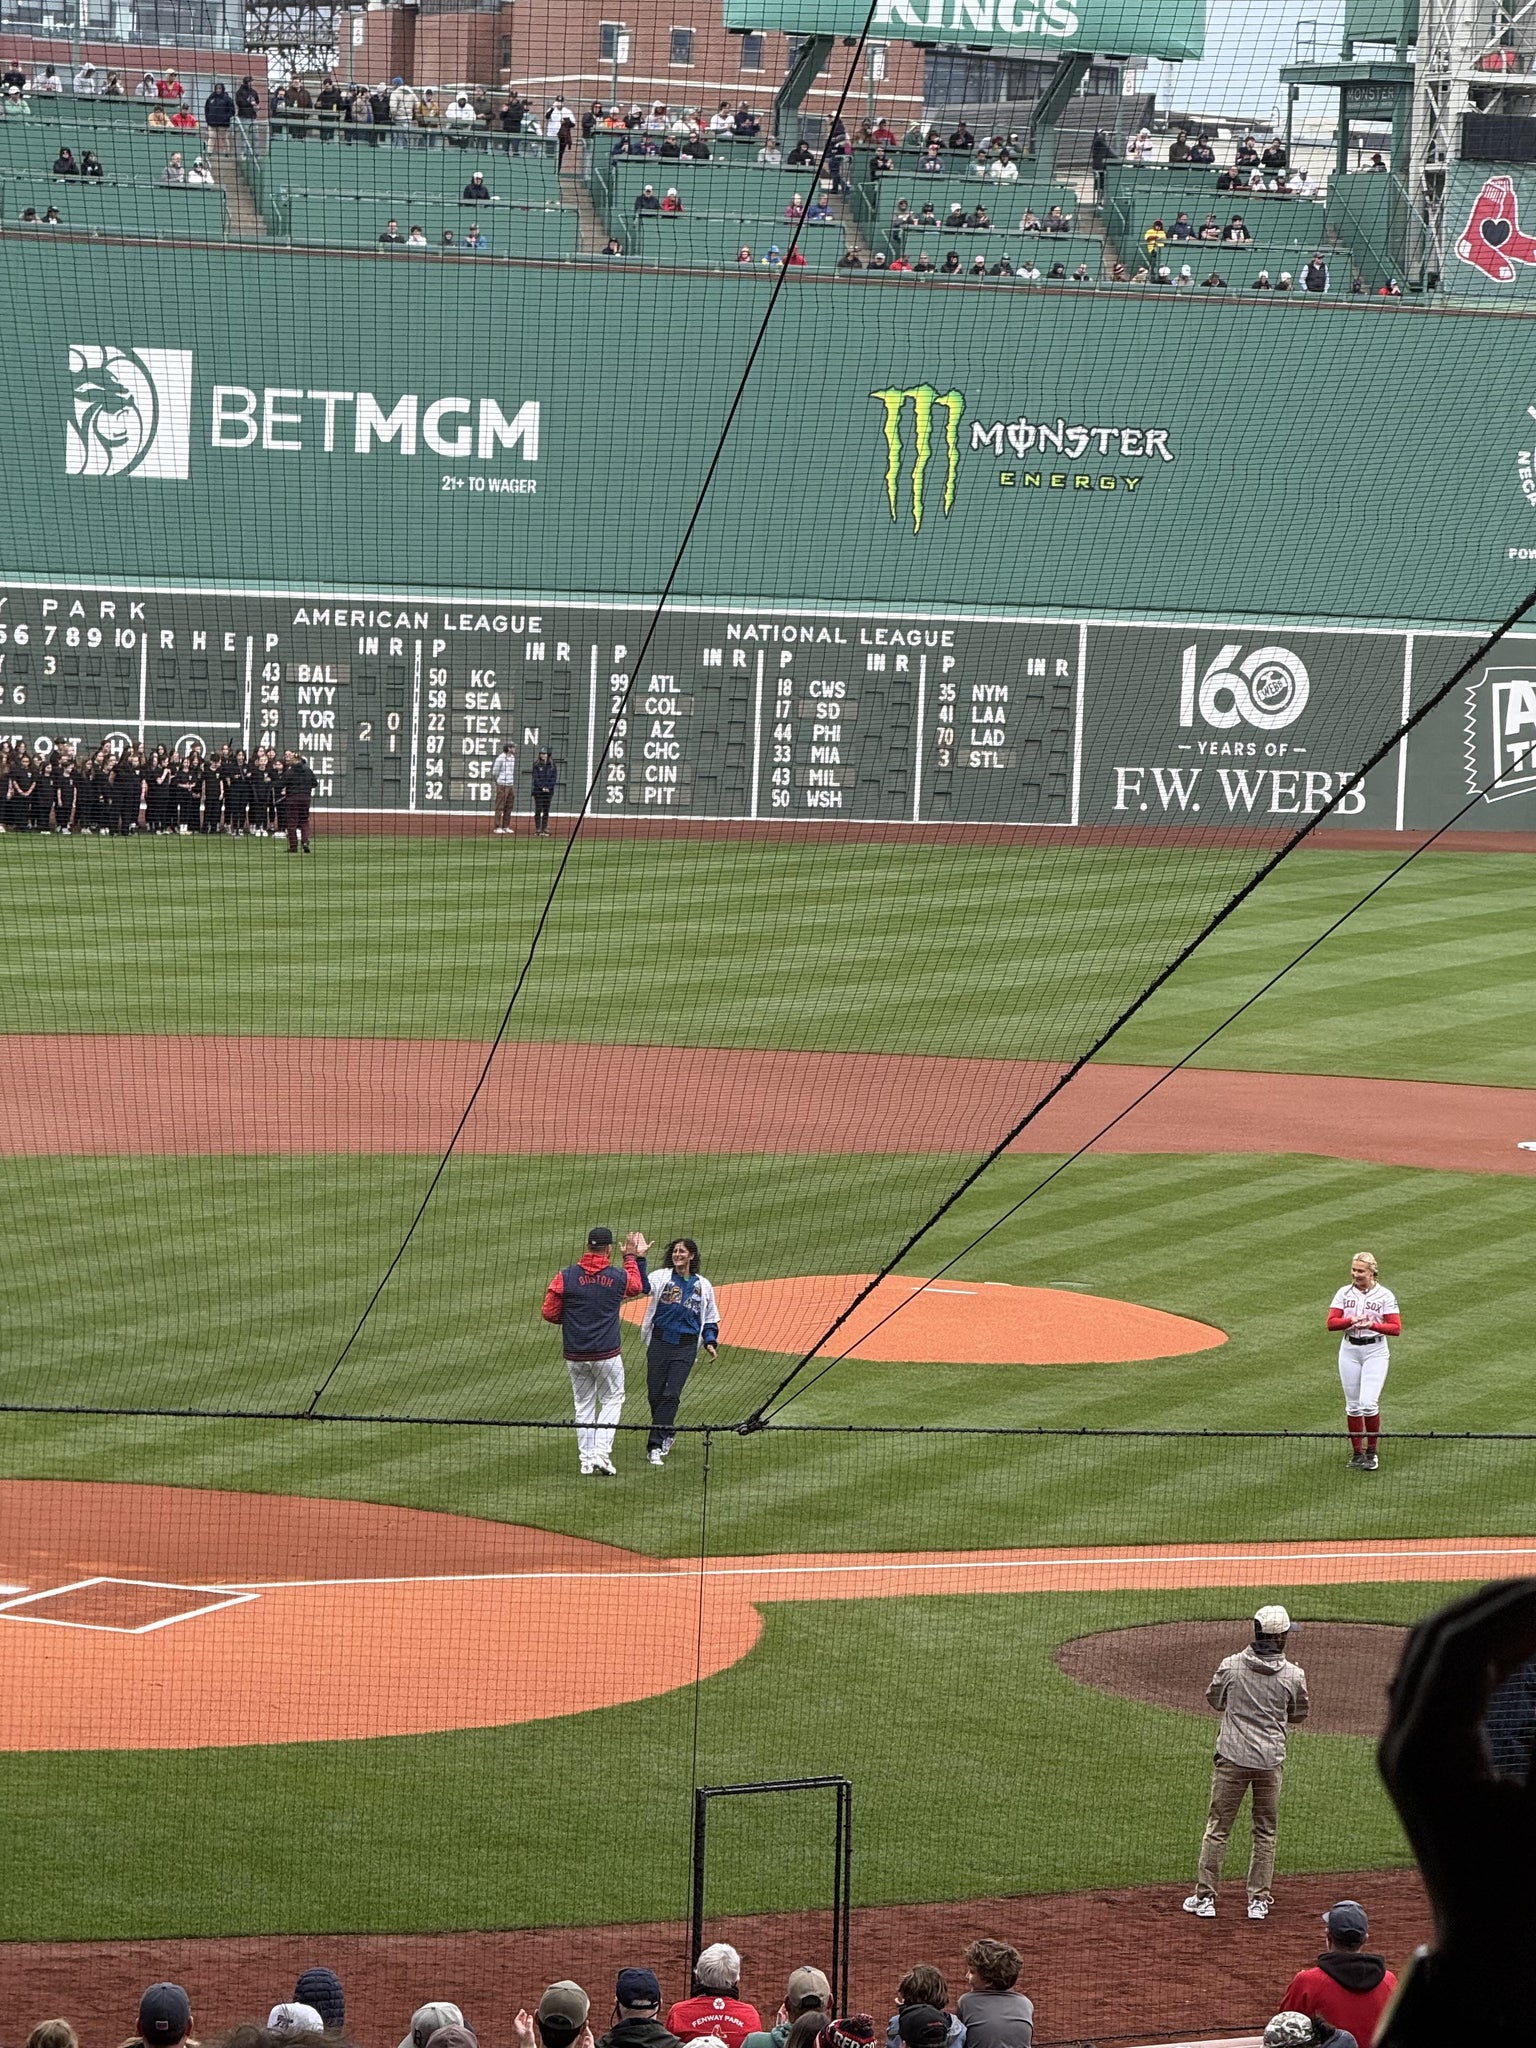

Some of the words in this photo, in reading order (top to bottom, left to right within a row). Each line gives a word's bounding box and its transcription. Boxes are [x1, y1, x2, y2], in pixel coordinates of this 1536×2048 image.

[1347, 86, 1394, 101] MONSTER
[211, 384, 542, 462] BETMGM
[970, 416, 1175, 463] MONSTER
[441, 475, 465, 491] 21+
[468, 476, 485, 492] TO
[488, 478, 537, 494] WAGER
[1000, 471, 1142, 492] ENERGY
[42, 598, 146, 621] PARK
[292, 607, 429, 630] AMERICAN
[443, 613, 543, 634] LEAGUE
[13, 623, 29, 646] 6
[44, 625, 58, 646] 7
[65, 626, 81, 647] 8
[86, 627, 102, 648] 9
[114, 627, 136, 649] 10
[160, 629, 175, 649] R
[192, 630, 207, 651] H
[224, 631, 236, 652] E
[265, 633, 279, 653] P
[726, 623, 848, 644] NATIONAL
[860, 627, 955, 648] LEAGUE
[389, 637, 403, 656] R
[432, 638, 446, 658] P
[556, 641, 571, 662] R
[614, 644, 628, 664] P
[43, 655, 56, 675] 3
[732, 648, 747, 668] R
[779, 650, 793, 669] P
[895, 654, 910, 673] R
[942, 655, 956, 674] P
[1055, 658, 1069, 677] R
[261, 662, 281, 682] 43
[298, 663, 338, 684] BAL
[429, 667, 448, 687] 50
[470, 669, 497, 689] KC
[610, 673, 629, 693] 99
[647, 674, 681, 693] ATL
[12, 685, 26, 705] 6
[260, 684, 280, 704] 54
[297, 685, 336, 706] NYY
[777, 678, 793, 697] 18
[809, 680, 846, 699] CWS
[938, 683, 956, 702] 35
[971, 684, 1009, 703] NYM
[1178, 644, 1310, 730] 160
[428, 689, 447, 709] 58
[464, 691, 502, 711] SEA
[644, 696, 683, 716] COL
[775, 699, 792, 719] 17
[815, 701, 841, 720] SD
[260, 708, 279, 728] 39
[297, 709, 336, 730] TOR
[427, 712, 446, 731] 22
[463, 714, 501, 734] TEX
[938, 704, 954, 724] 41
[971, 705, 1006, 724] LAA
[359, 722, 372, 742] 2
[524, 727, 539, 746] N
[650, 719, 676, 739] AZ
[773, 723, 792, 742] 44
[812, 723, 842, 742] PHI
[970, 728, 1006, 747] LAD
[34, 736, 81, 758] OT
[298, 732, 333, 752] MIN
[426, 735, 445, 754] 87
[461, 736, 502, 758] DET
[643, 741, 681, 761] CHC
[1197, 741, 1257, 756] YEARS
[1264, 742, 1289, 757] OF
[772, 744, 791, 763] 33
[810, 745, 841, 765] MIA
[969, 750, 1005, 769] STL
[304, 756, 335, 776] LE
[425, 758, 444, 777] 54
[468, 760, 493, 779] SF
[607, 763, 626, 782] 26
[644, 764, 678, 784] CIN
[771, 767, 791, 786] 43
[808, 768, 841, 787] MIL
[425, 780, 443, 800] 32
[466, 782, 492, 801] TB
[605, 785, 624, 804] 35
[644, 786, 676, 805] PIT
[771, 788, 790, 808] 50
[806, 789, 843, 808] WSH
[1110, 767, 1203, 812] F.W.
[1217, 769, 1367, 816] WEBB
[578, 1274, 614, 1288] BOSTON
[1365, 1301, 1382, 1314] SOX
[691, 2014, 724, 2028] FENWAY
[724, 2015, 744, 2028] PARK
